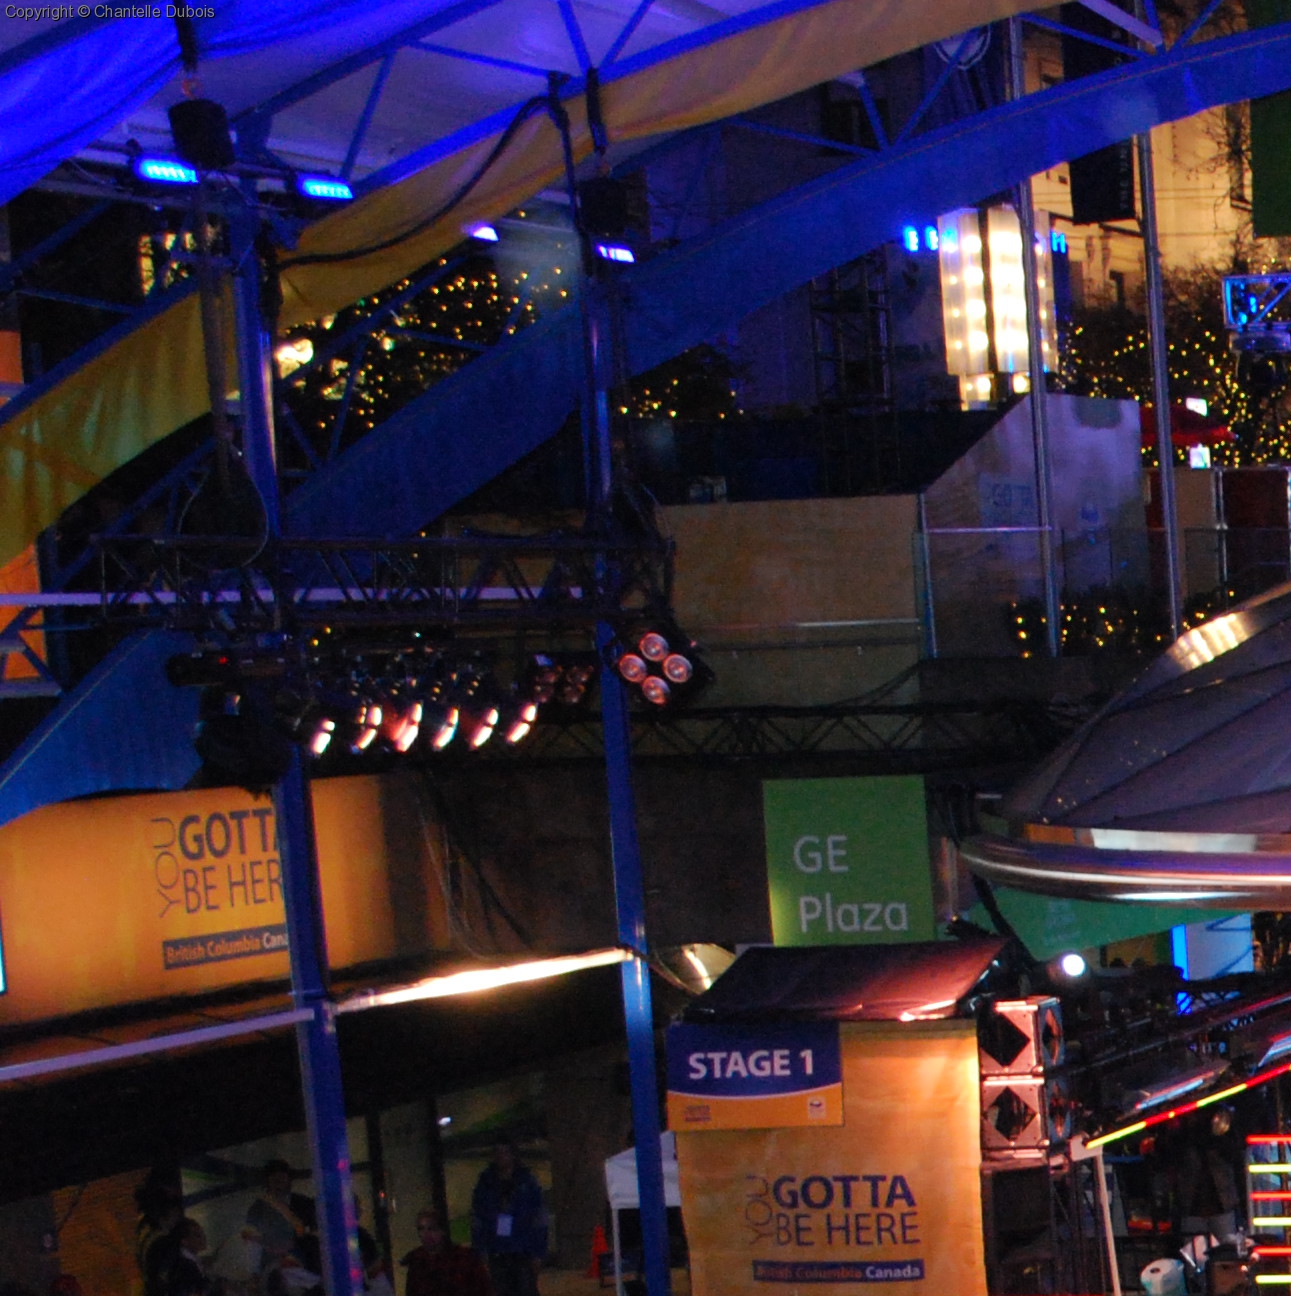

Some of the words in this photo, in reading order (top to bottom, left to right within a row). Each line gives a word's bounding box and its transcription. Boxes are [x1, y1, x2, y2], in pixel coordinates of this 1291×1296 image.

[178, 807, 279, 861] GOTT
[793, 834, 849, 874] GE
[151, 816, 181, 919] YOU
[183, 865, 221, 914] BE
[227, 858, 284, 908] HER
[799, 892, 909, 933] Plaza
[688, 1049, 792, 1081] STAGE
[800, 1049, 814, 1076] 1
[745, 1174, 774, 1245] YOU
[772, 1174, 917, 1210] GOTTA
[776, 1213, 815, 1247] BE
[825, 1211, 921, 1247] HERE
[865, 1264, 921, 1279] Canada
